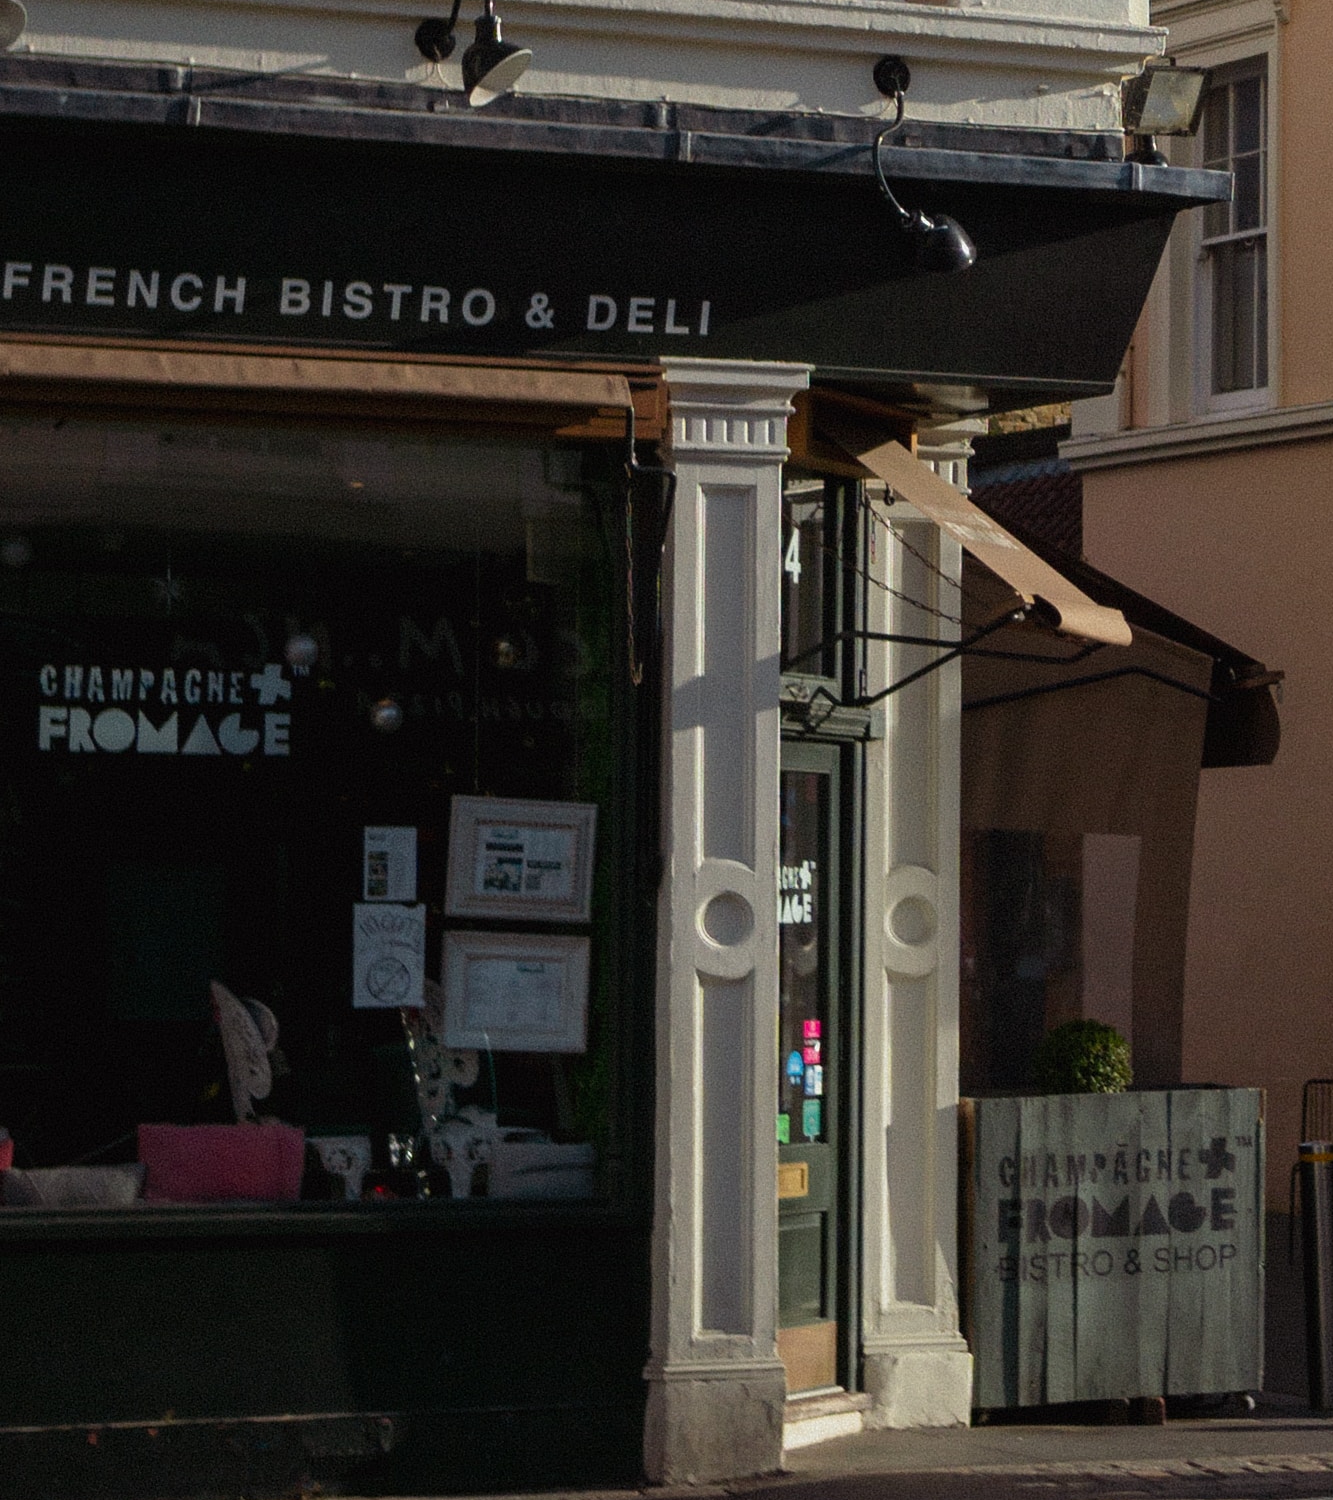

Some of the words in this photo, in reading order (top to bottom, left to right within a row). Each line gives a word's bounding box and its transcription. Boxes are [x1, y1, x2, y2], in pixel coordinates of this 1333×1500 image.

[3, 261, 247, 315] FRENCH
[280, 277, 496, 327] BISTRO
[525, 292, 554, 329] &
[587, 294, 711, 336] DELI
[785, 529, 802, 584] 4
[40, 664, 244, 705] CHAMPAGNE
[39, 705, 291, 756] FROMAGE
[998, 1187, 1237, 1244] FROMAGE
[998, 1252, 1114, 1283] BISTRO
[1123, 1249, 1142, 1276] &
[1154, 1244, 1237, 1273] SHOP
